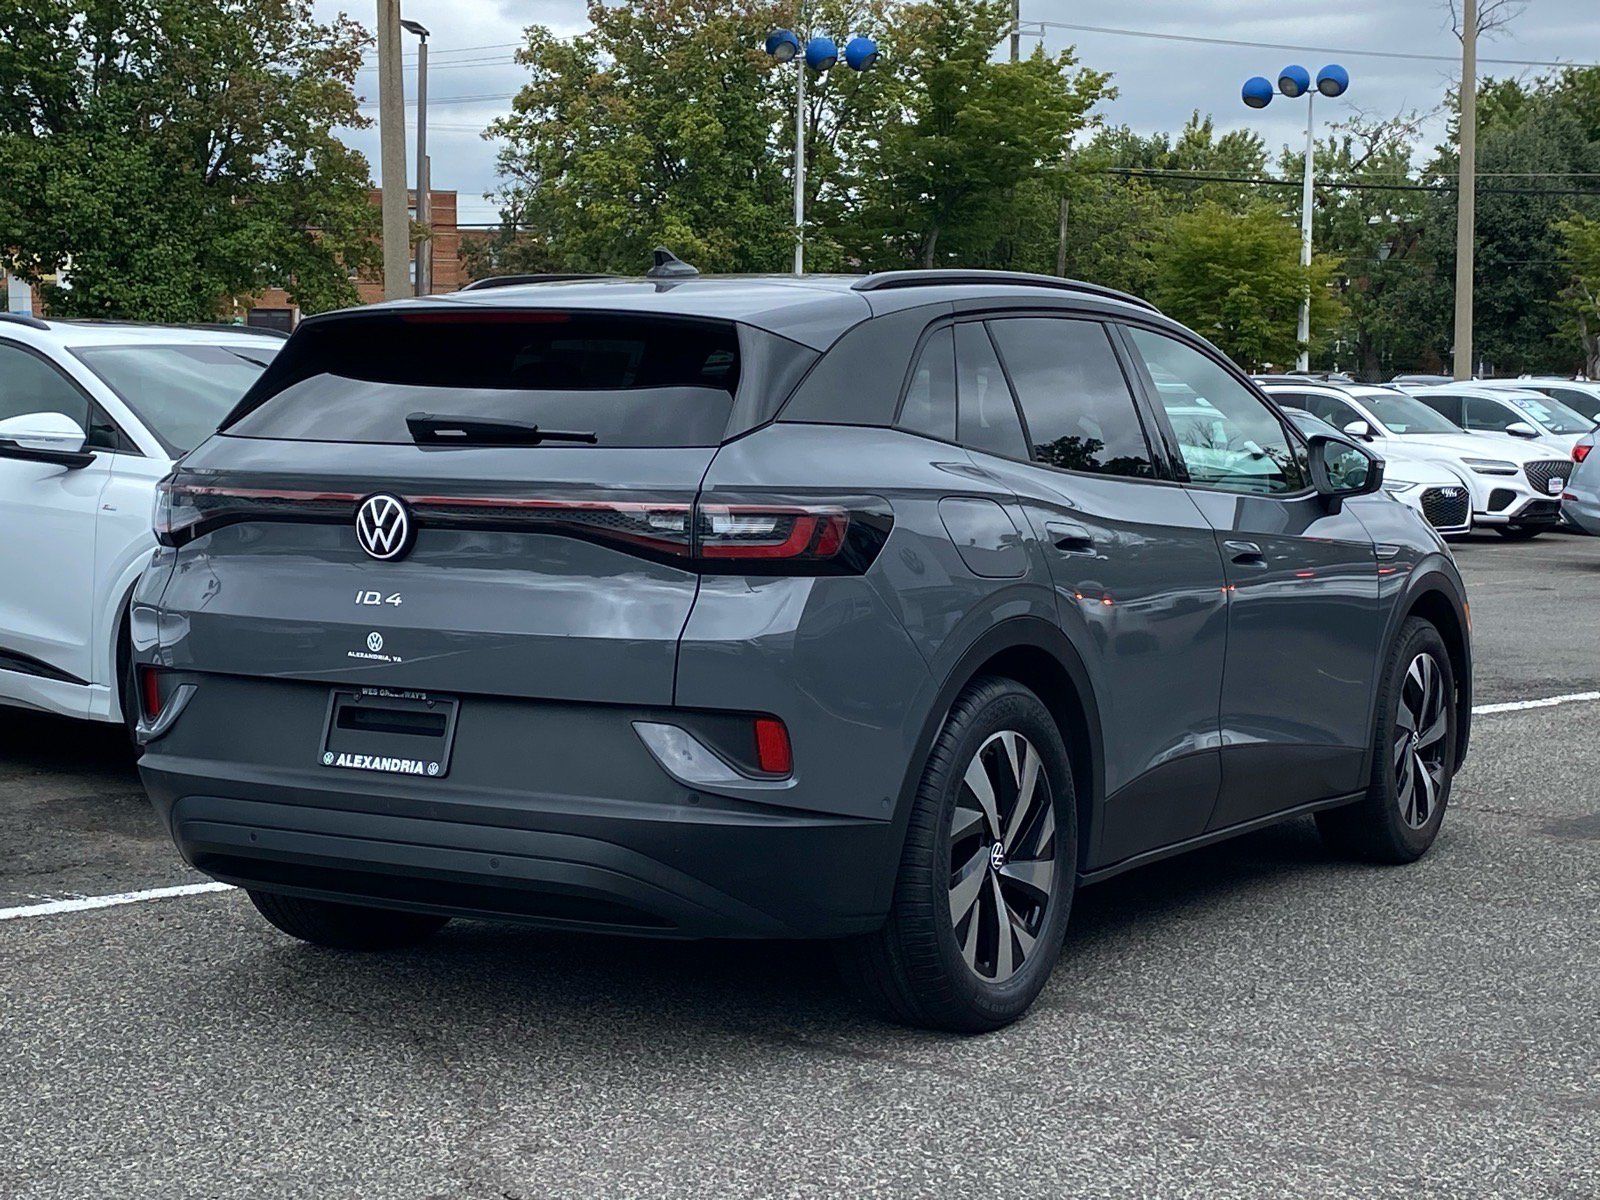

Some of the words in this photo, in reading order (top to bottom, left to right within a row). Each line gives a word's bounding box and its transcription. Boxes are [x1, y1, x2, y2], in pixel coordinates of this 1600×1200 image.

[347, 651, 392, 662] ALEXANDRIA,
[362, 688, 378, 696] WES
[336, 753, 424, 774] ALEXANDRIA
